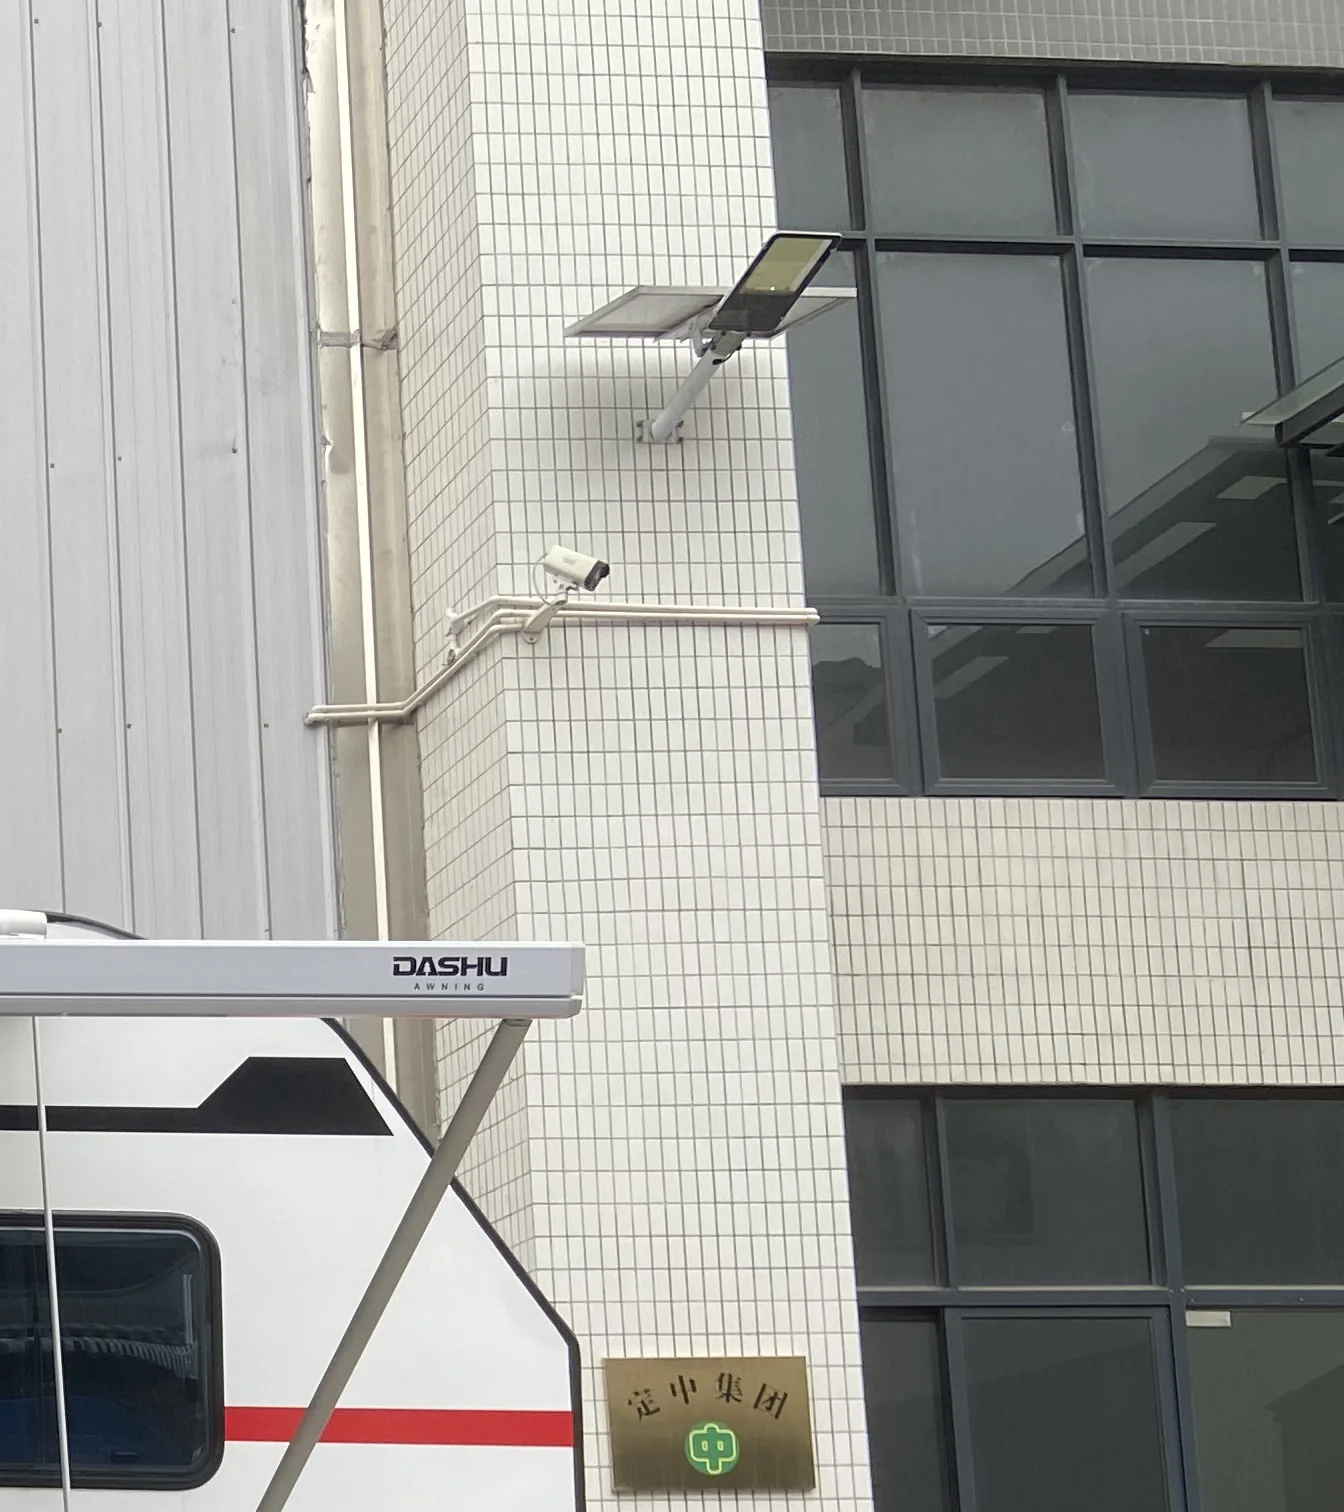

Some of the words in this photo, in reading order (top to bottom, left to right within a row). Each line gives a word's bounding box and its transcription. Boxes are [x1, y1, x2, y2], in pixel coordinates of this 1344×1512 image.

[393, 956, 508, 977] DASHU
[414, 983, 485, 991] AWNING
[627, 1372, 788, 1423] 定中集团
